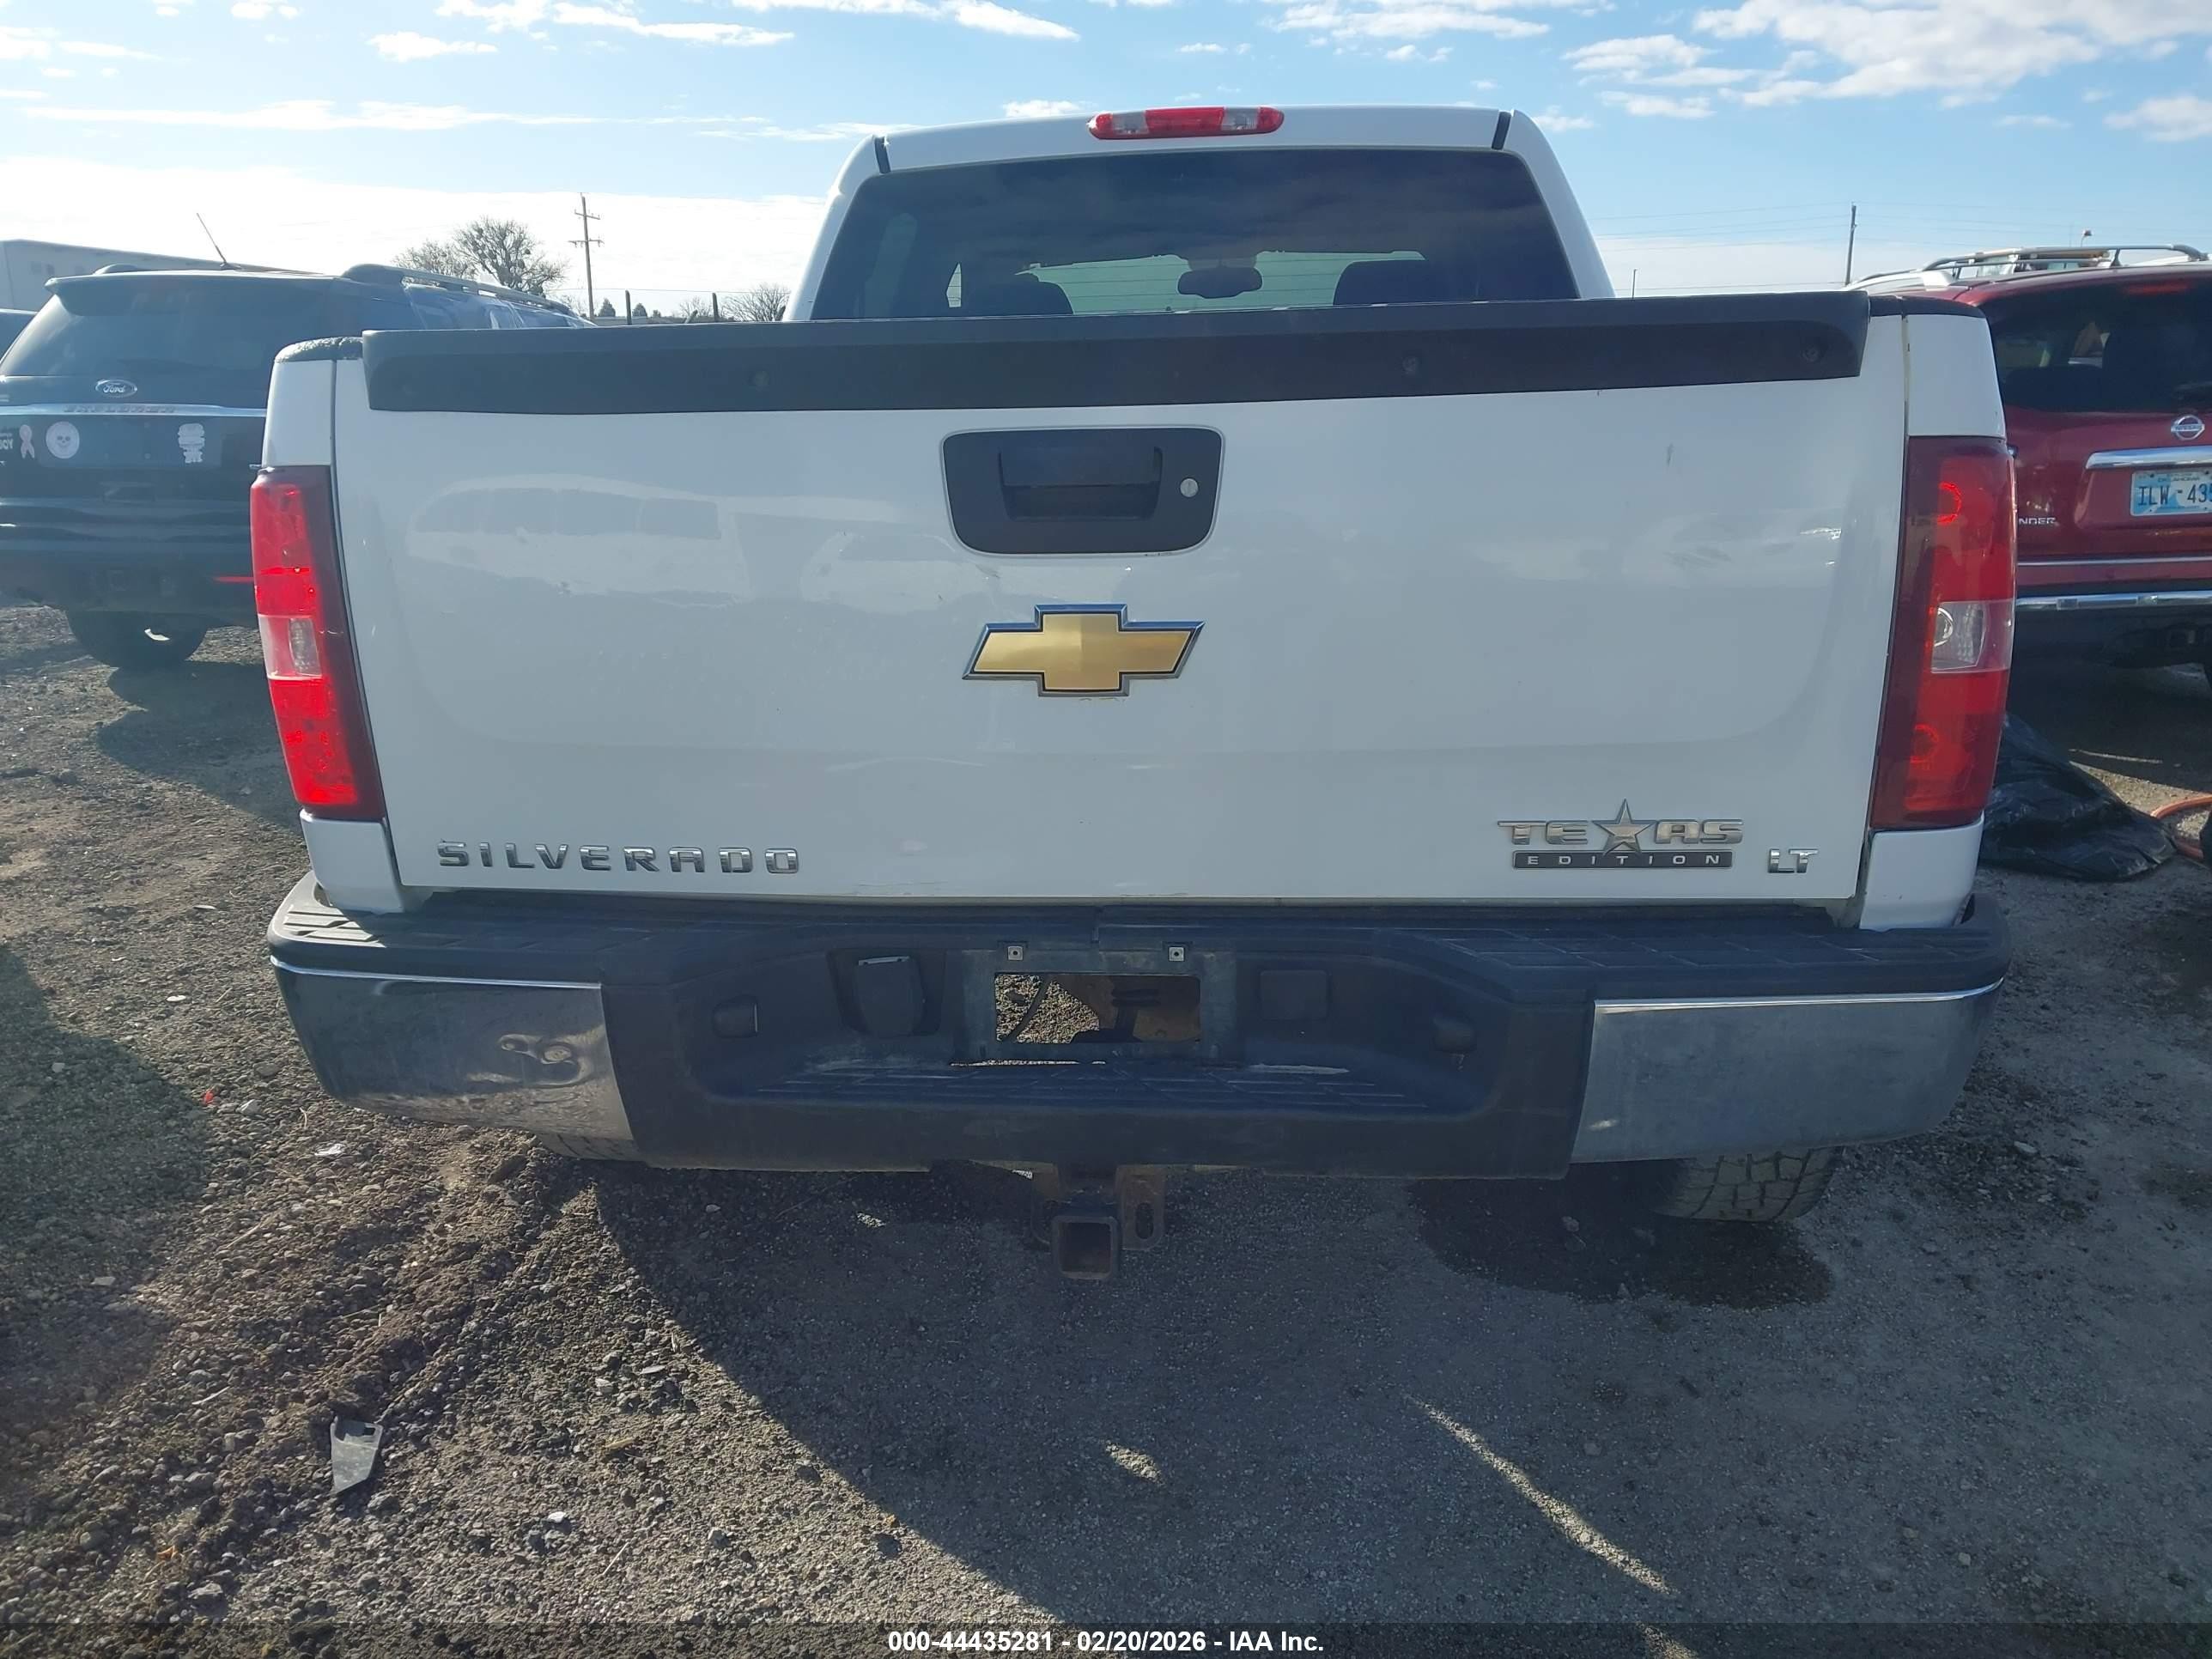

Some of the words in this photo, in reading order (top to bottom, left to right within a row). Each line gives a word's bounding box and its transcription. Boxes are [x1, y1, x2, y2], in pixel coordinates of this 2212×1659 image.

[102, 384, 125, 393] Ford
[437, 840, 799, 874] SILVERADO
[1527, 854, 1721, 866] EDITION
[1767, 848, 1819, 874] LT
